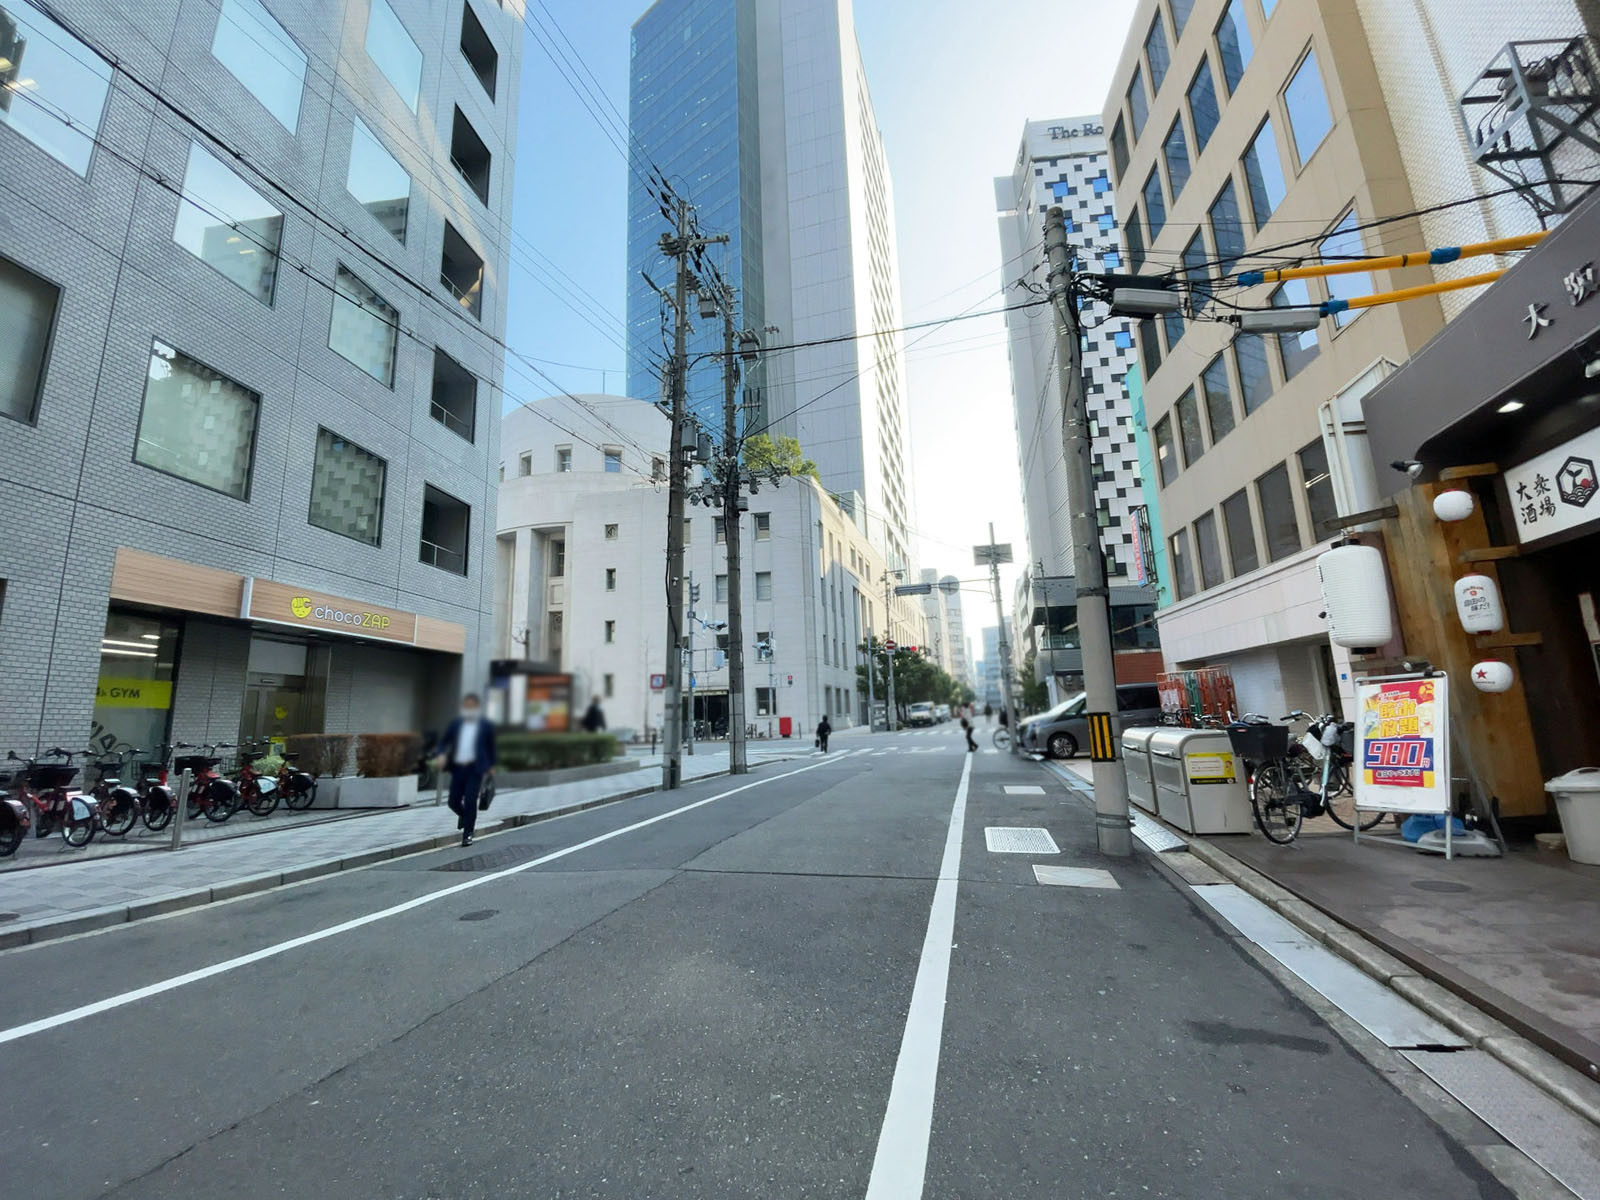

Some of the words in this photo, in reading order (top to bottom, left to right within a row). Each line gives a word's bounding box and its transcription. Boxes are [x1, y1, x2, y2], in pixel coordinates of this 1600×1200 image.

[1047, 126, 1079, 140] The
[1521, 496, 1556, 525] 酒場
[314, 605, 391, 630] chocoZAP
[110, 687, 140, 699] GYM
